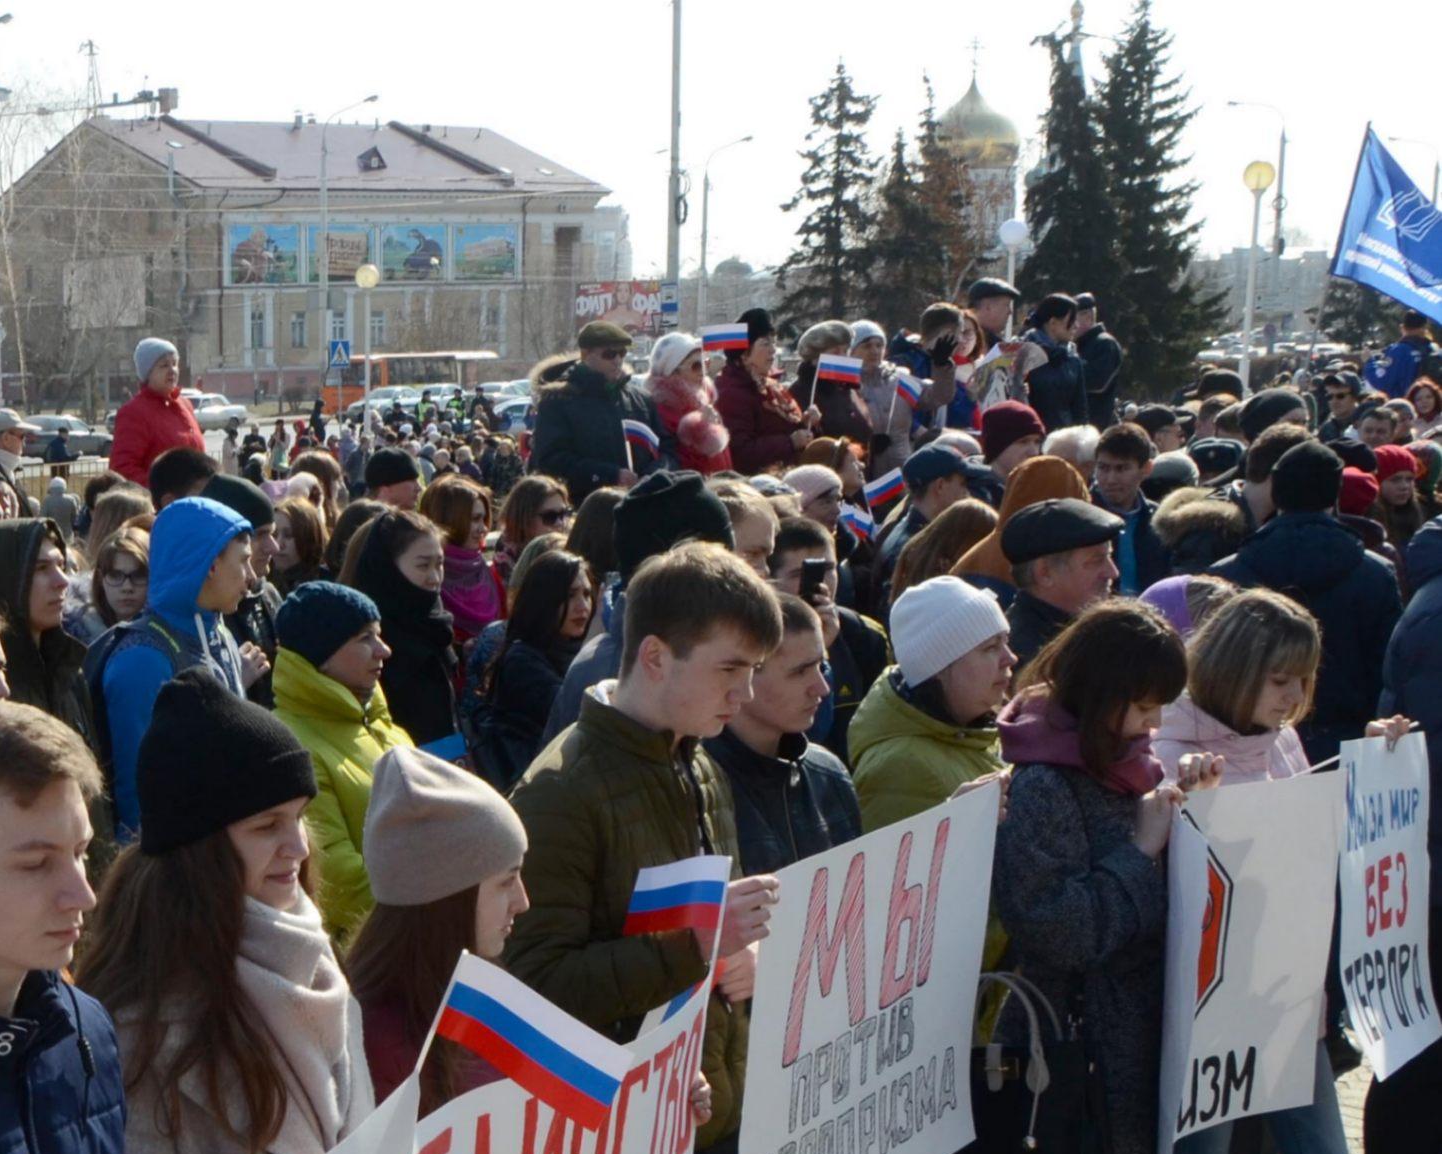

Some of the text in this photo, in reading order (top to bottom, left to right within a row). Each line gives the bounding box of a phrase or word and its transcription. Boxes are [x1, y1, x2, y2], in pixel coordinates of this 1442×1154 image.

[782, 817, 950, 1069] МЫ
[1364, 852, 1408, 938] БЕЗ
[1344, 943, 1430, 1046] ТЕРРОРА
[788, 996, 915, 1134] ПРОТИВ
[1176, 1045, 1257, 1133] ИЗМ
